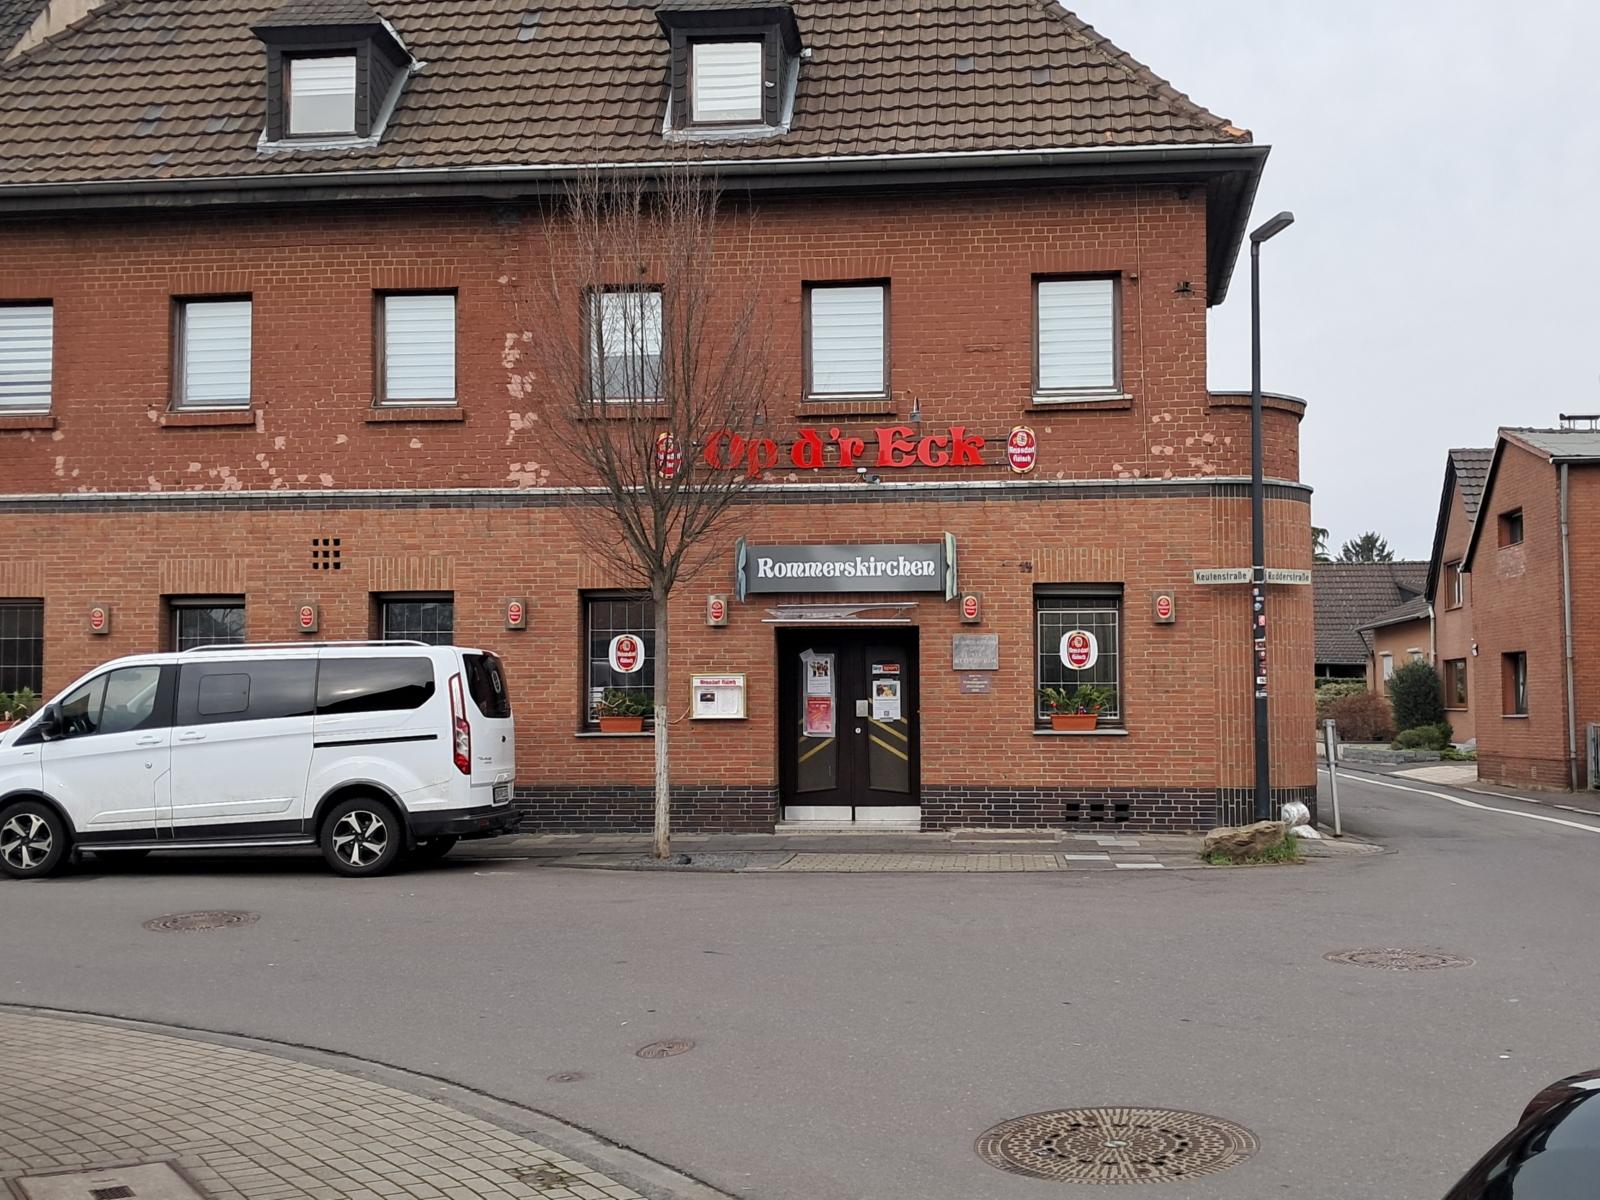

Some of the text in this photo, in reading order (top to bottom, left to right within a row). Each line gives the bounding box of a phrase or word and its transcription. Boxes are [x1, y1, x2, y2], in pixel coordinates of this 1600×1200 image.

[704, 428, 778, 479] Op
[874, 426, 985, 467] Eck
[757, 556, 935, 578] Rommerskirchen
[1196, 571, 1247, 581] Keutenstraße
